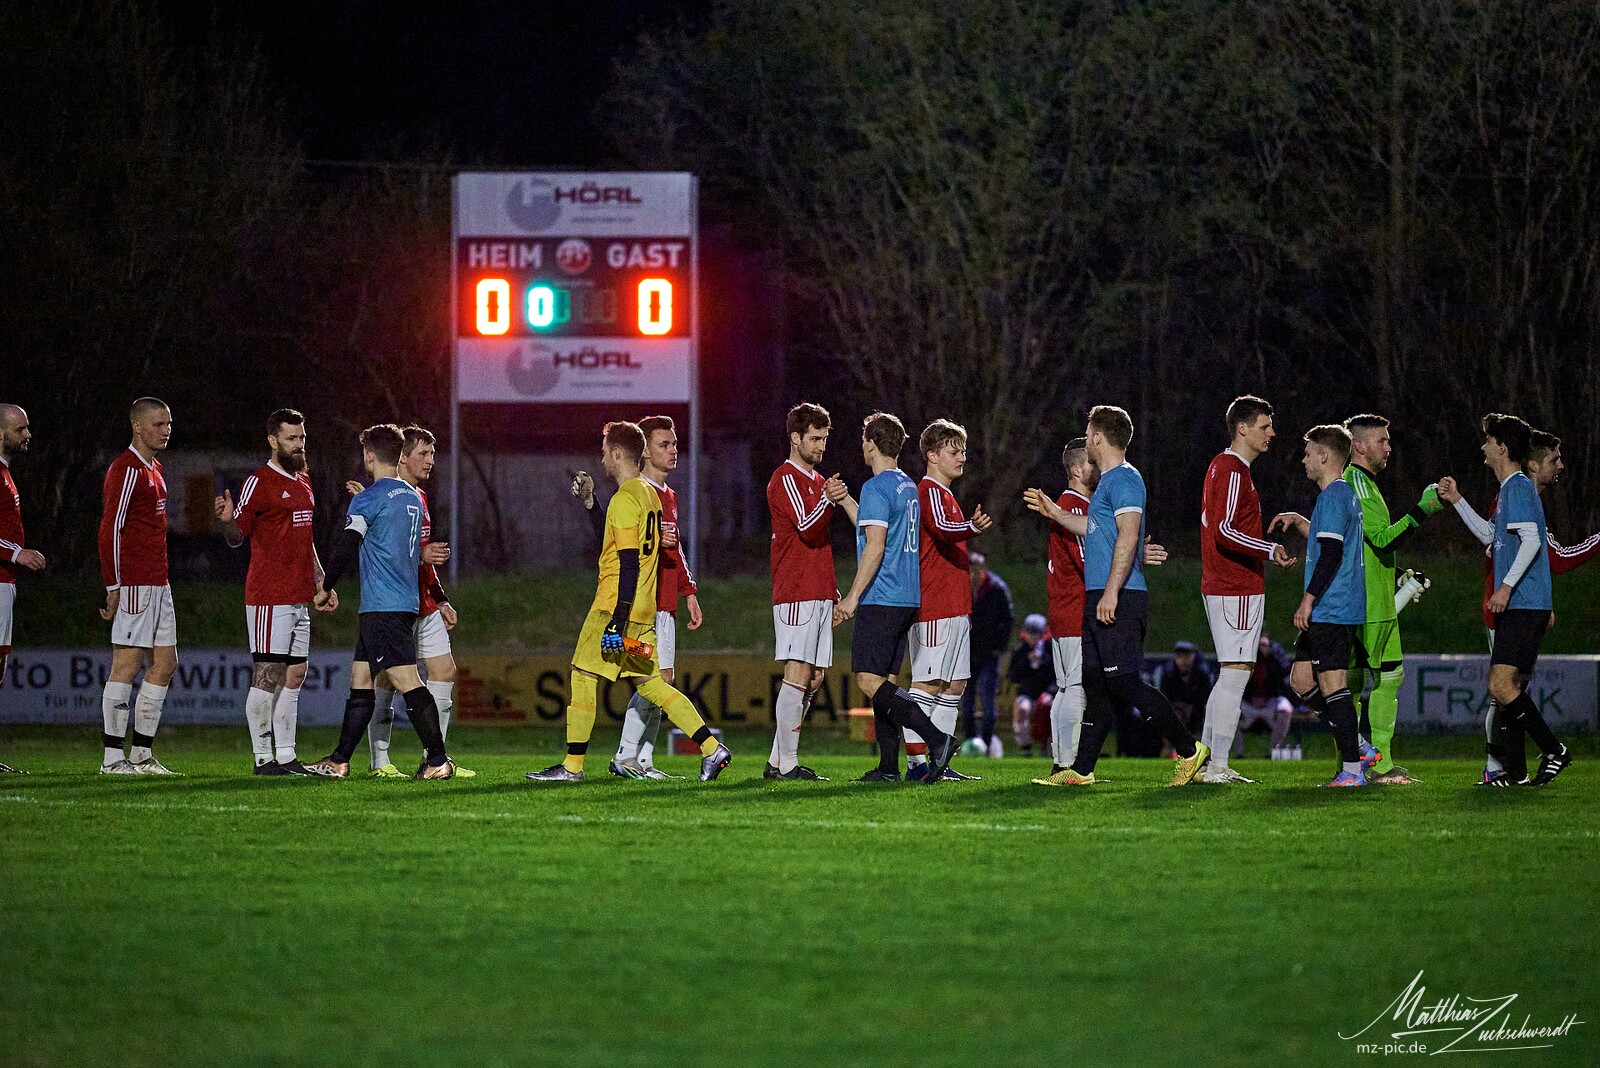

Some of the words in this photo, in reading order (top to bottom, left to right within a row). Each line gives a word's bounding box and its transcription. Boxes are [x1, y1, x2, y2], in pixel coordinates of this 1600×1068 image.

[554, 181, 642, 204] HÖRL
[468, 243, 542, 268] HEIM
[606, 243, 684, 268] GAST
[476, 278, 510, 335] 0
[527, 286, 554, 328] 0
[638, 278, 672, 335] 0
[553, 346, 642, 369] HÖRL
[406, 505, 419, 557] 7
[6, 657, 52, 690] to
[1417, 666, 1563, 715] FRK
